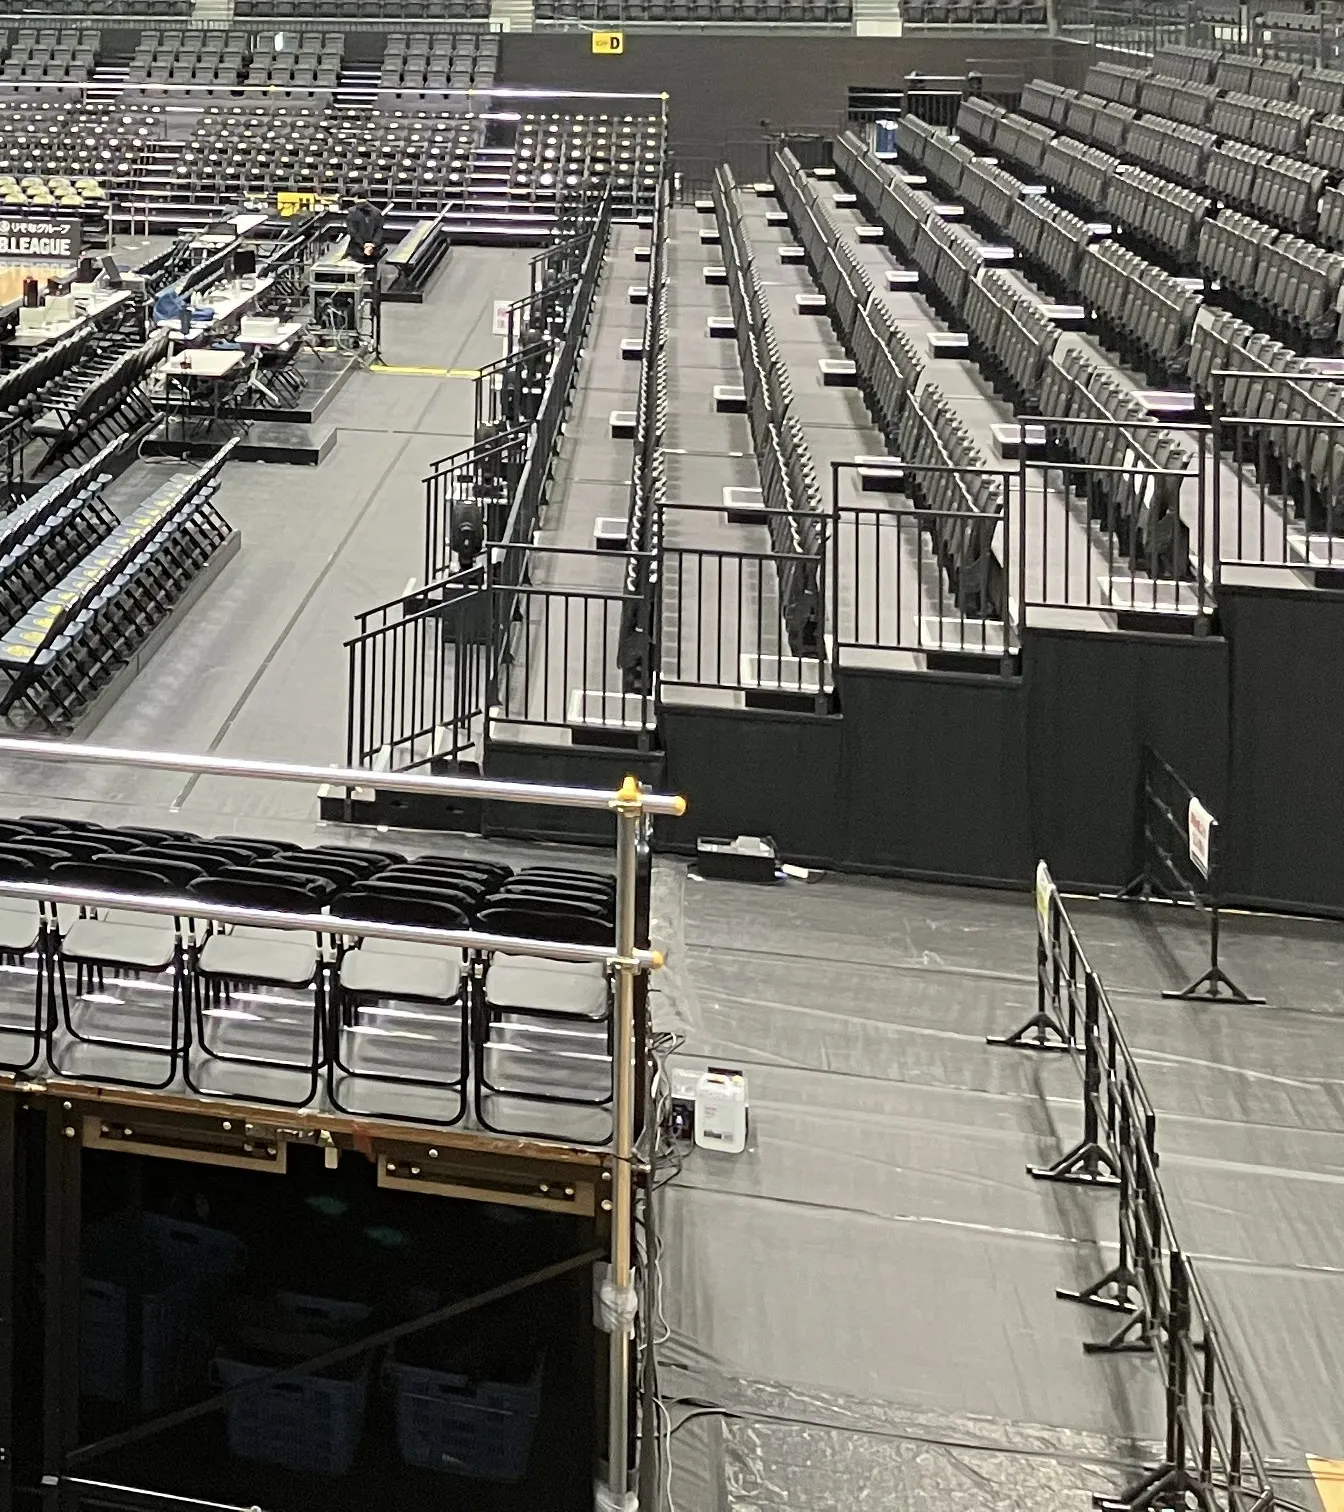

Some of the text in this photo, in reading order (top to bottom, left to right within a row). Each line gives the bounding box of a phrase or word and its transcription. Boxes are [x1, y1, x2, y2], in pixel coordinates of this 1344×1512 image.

[610, 36, 620, 49] D
[10, 221, 72, 235] りそなグループ
